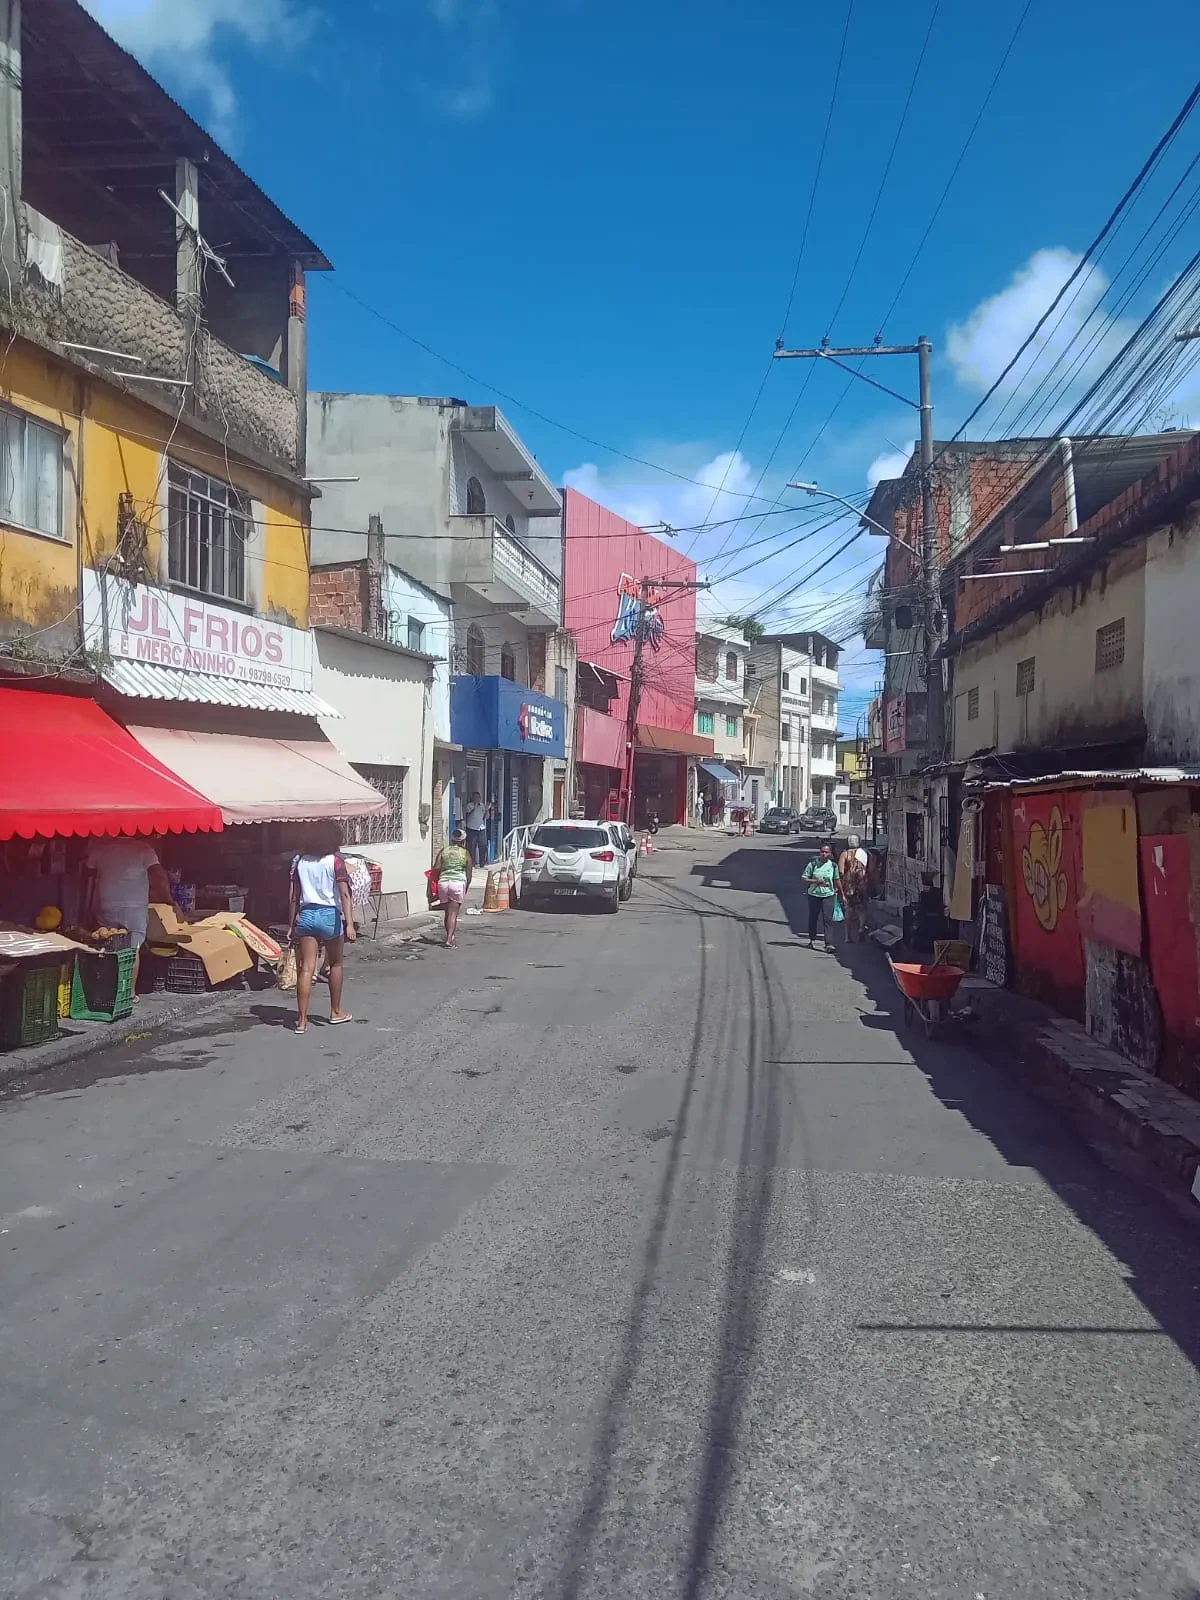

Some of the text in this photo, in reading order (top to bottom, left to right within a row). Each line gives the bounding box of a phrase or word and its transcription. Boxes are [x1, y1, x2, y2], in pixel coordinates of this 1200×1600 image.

[120, 634, 129, 655] E
[136, 638, 236, 676] MERCADINHO
[128, 594, 284, 663] JL FRIOS
